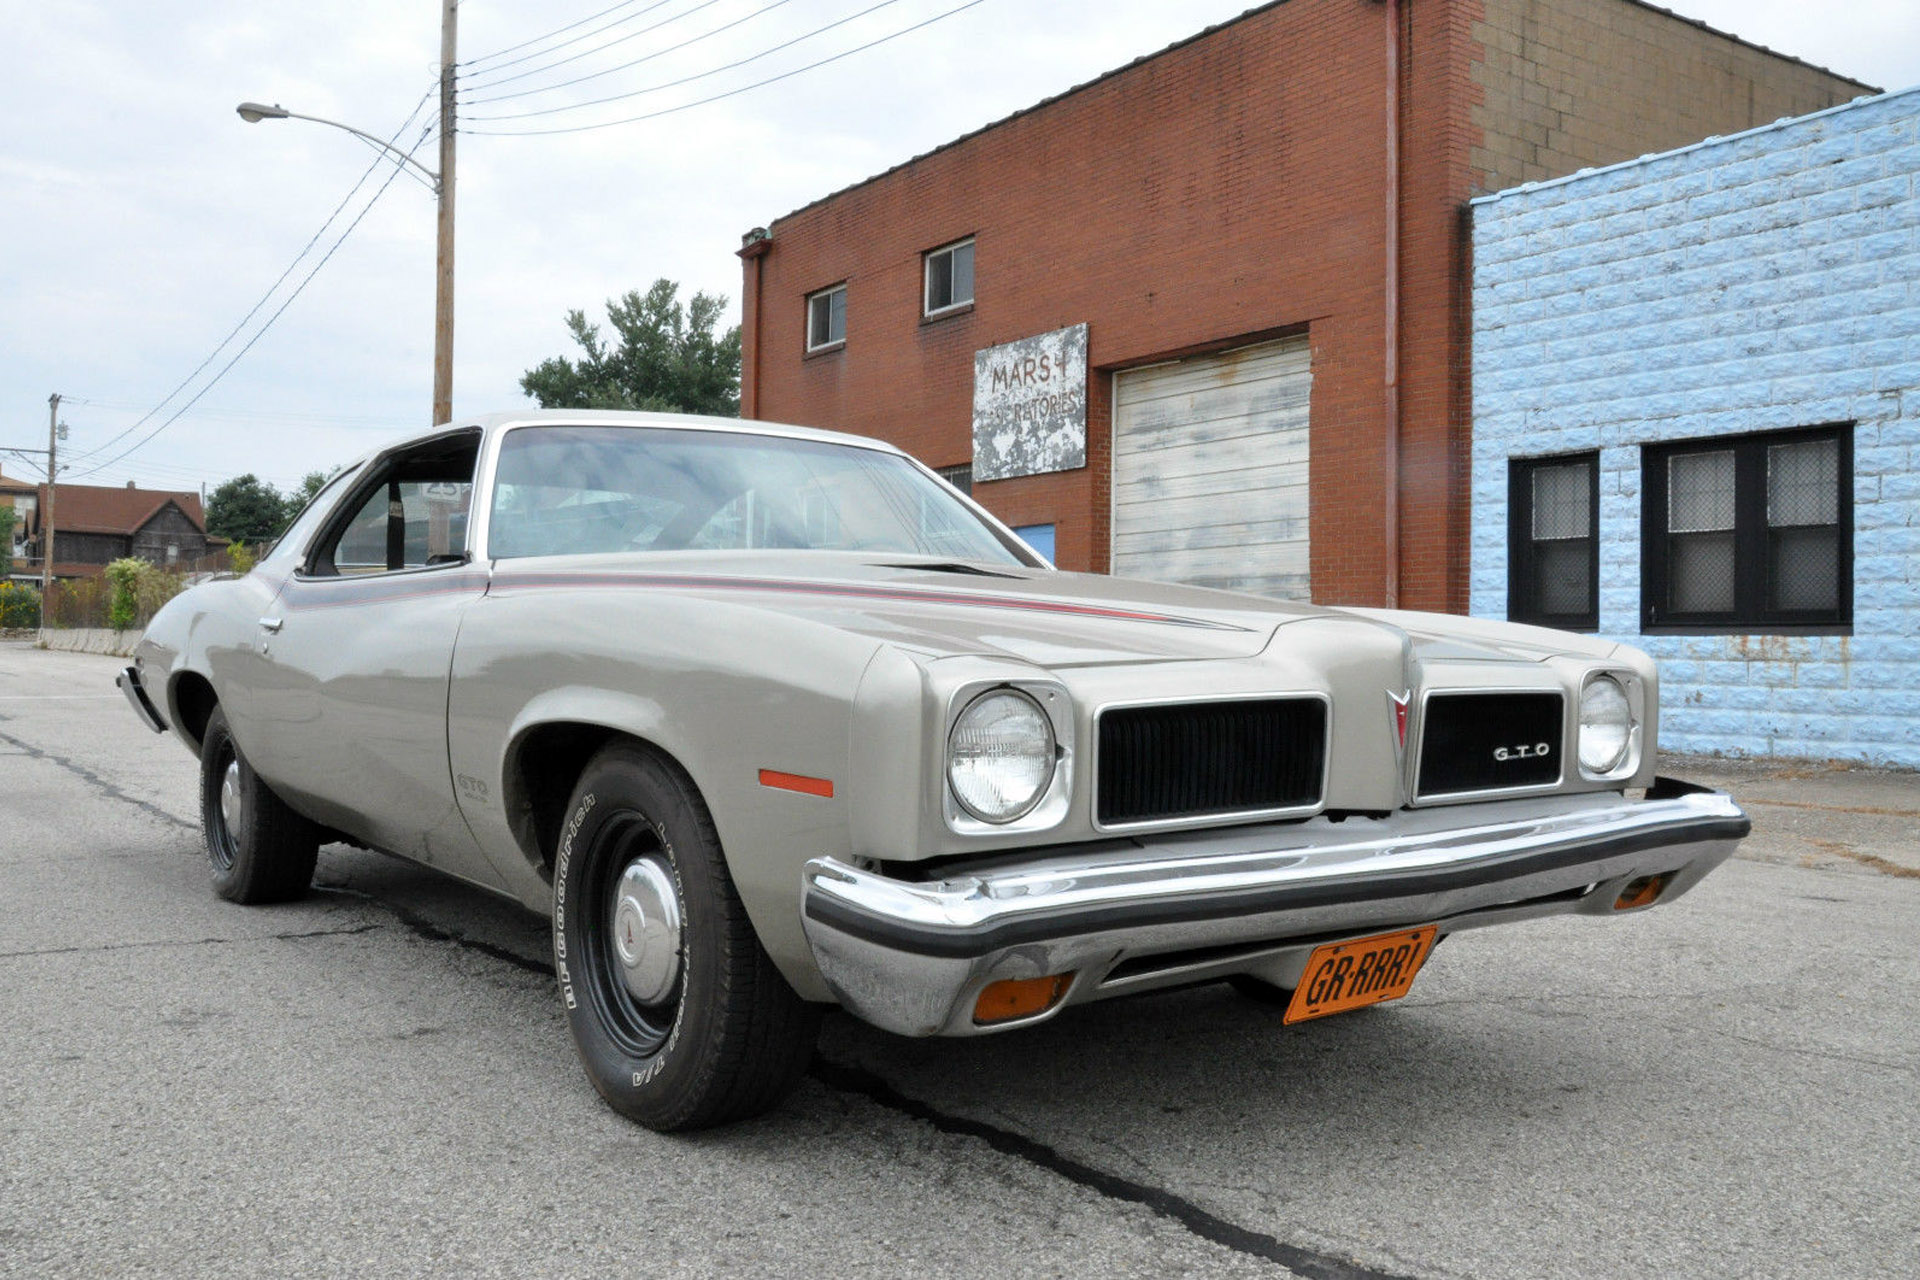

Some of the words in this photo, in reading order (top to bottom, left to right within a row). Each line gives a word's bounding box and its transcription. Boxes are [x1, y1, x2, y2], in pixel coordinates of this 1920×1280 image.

[1493, 742, 1550, 762] GTO
[556, 793, 597, 1010] BFGoodrich
[632, 1056, 666, 1087] T/A
